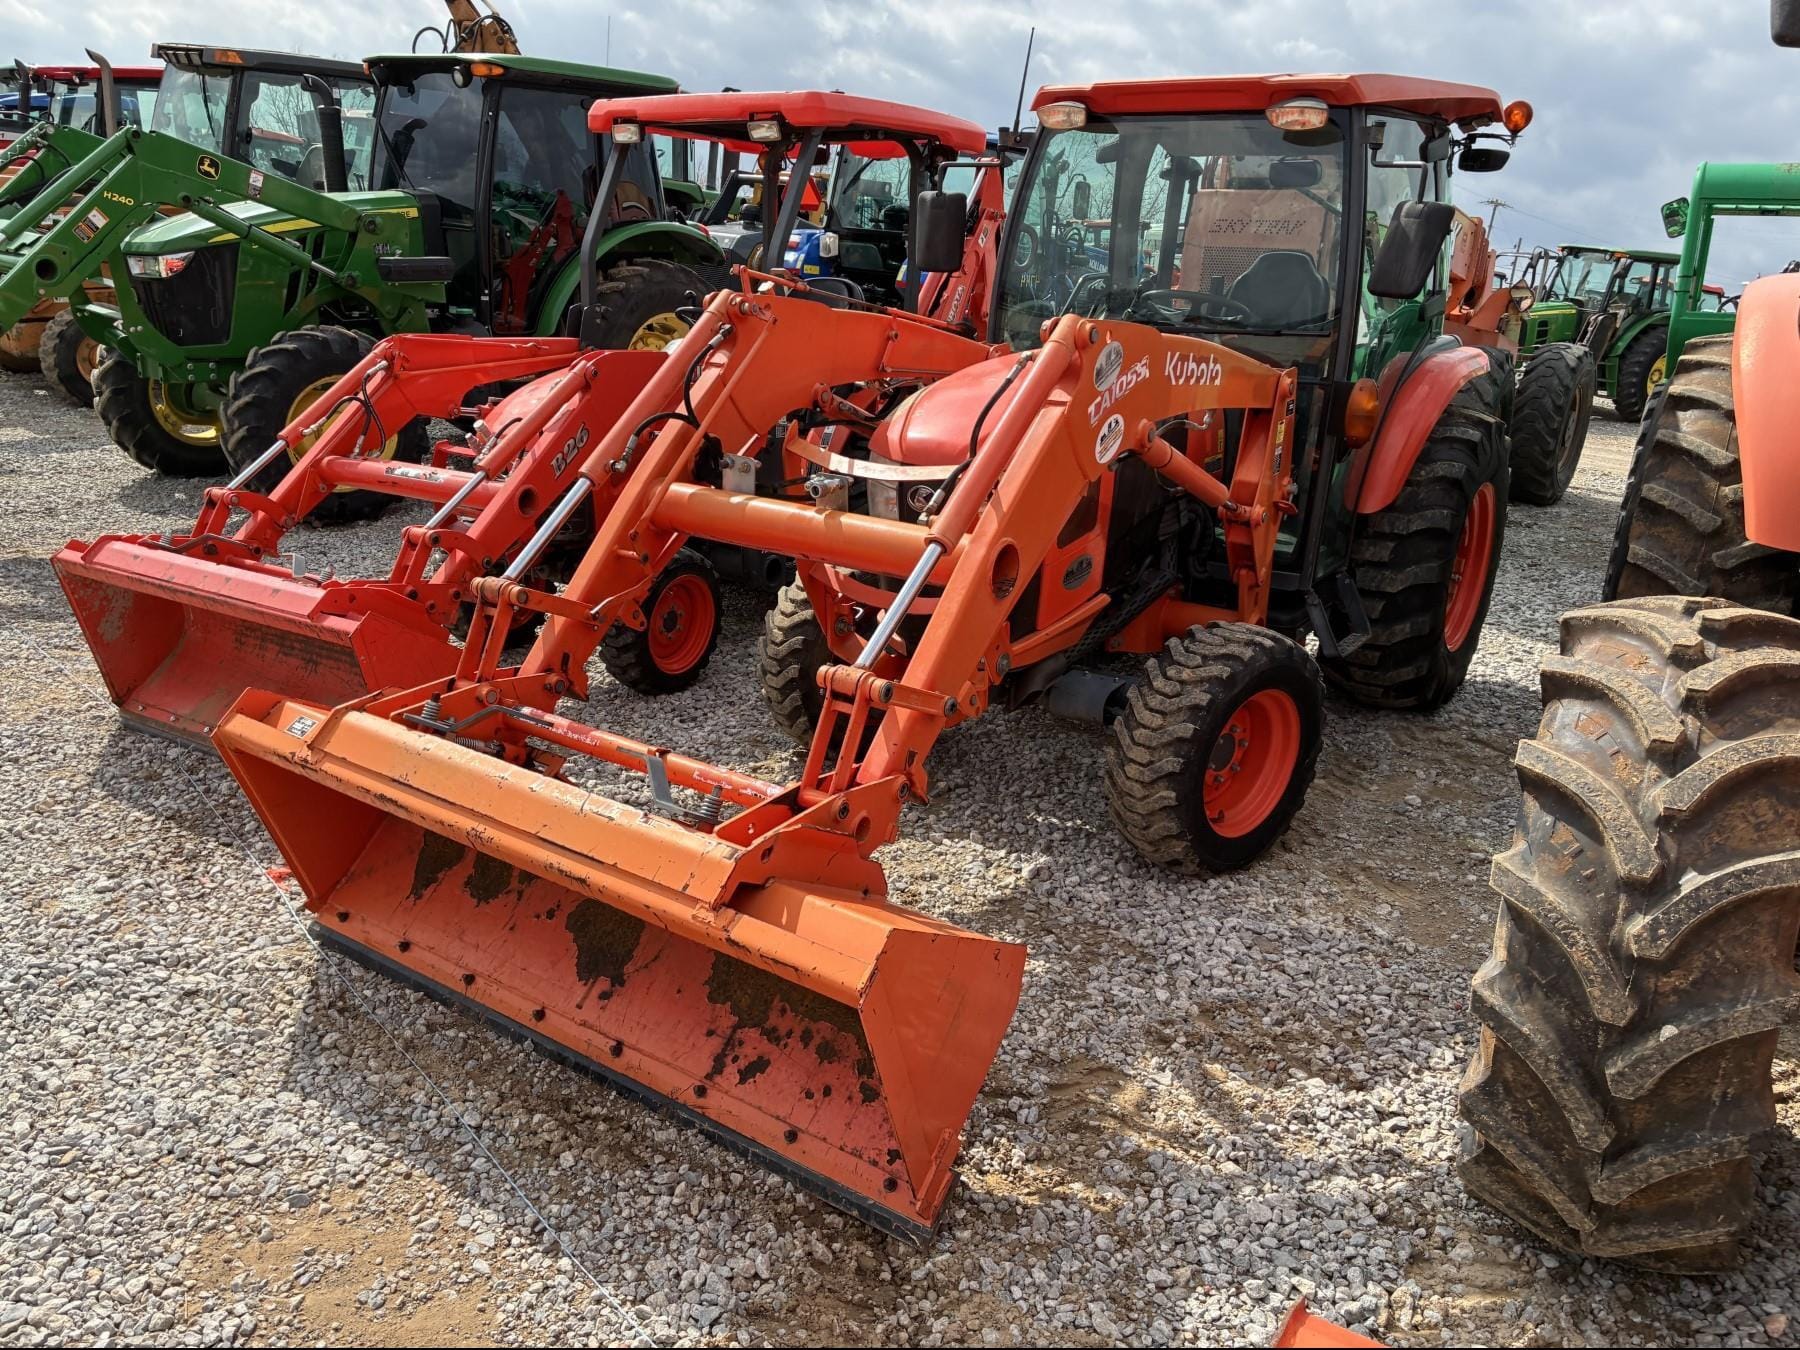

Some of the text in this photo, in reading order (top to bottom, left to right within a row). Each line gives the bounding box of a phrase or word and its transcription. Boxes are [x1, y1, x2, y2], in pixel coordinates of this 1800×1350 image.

[103, 190, 135, 206] H240
[1165, 351, 1222, 386] Kubota
[550, 423, 589, 480] B26
